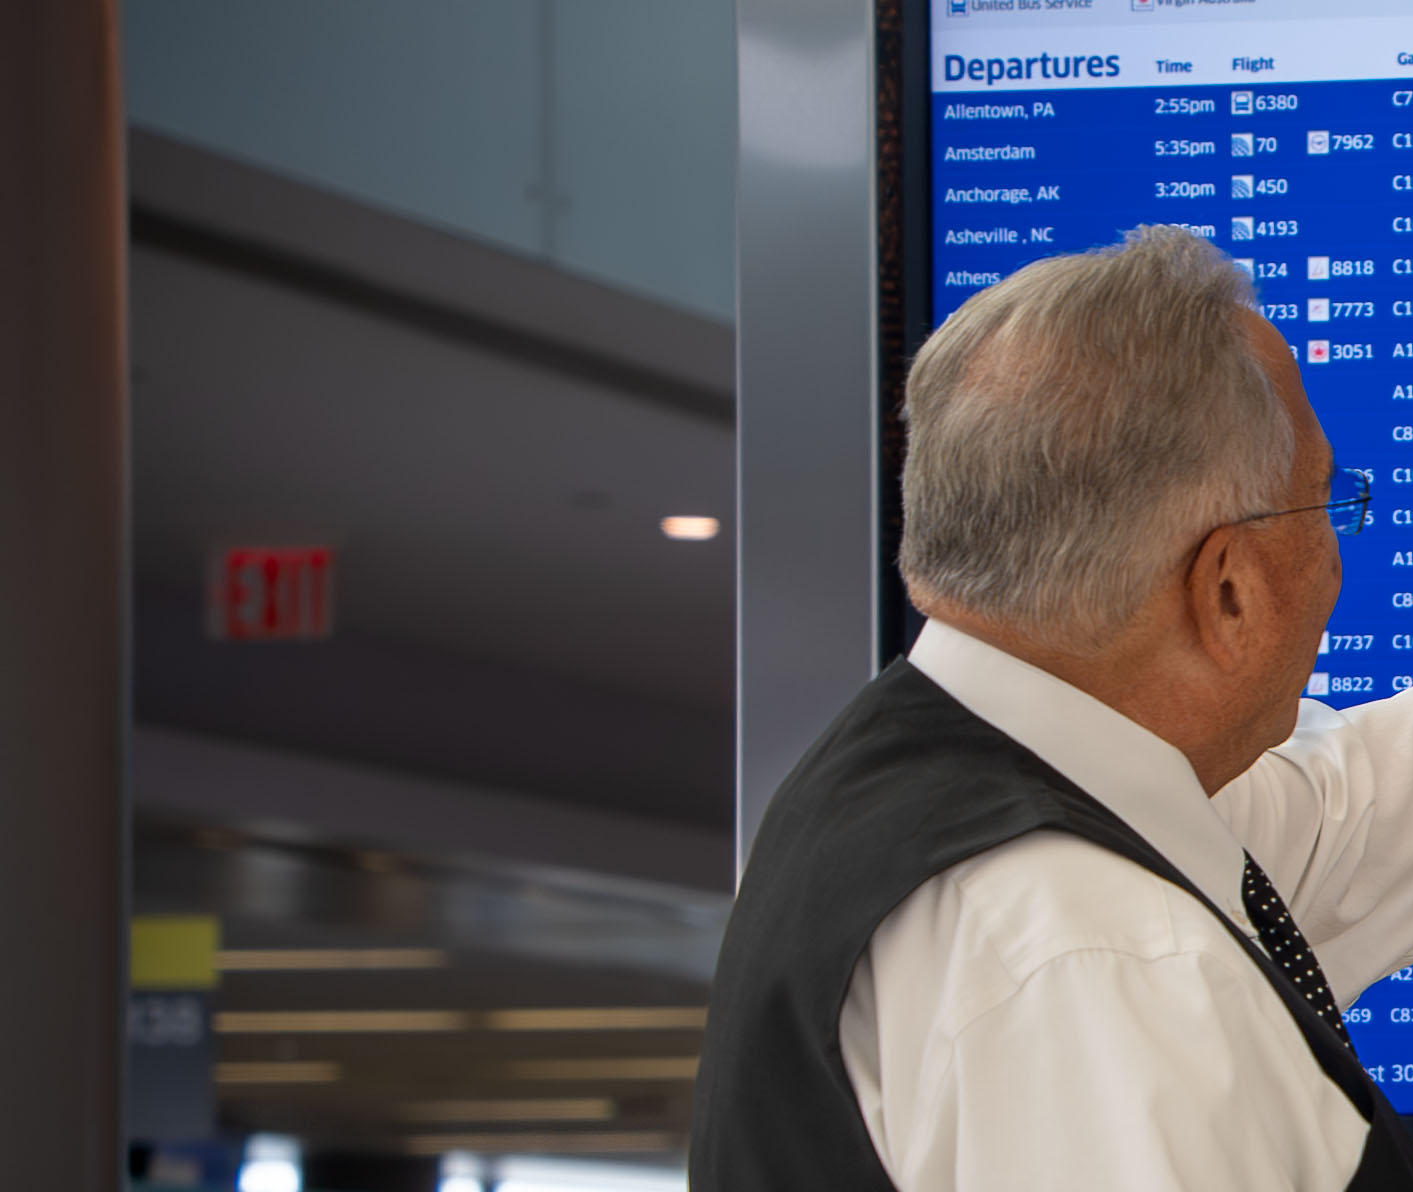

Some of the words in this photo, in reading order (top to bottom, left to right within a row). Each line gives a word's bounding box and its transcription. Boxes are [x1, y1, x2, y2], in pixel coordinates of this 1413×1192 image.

[944, 52, 1121, 85] Departures
[1156, 59, 1193, 74] Time
[1231, 56, 1275, 73] Flight
[944, 103, 1029, 120] Allentown,
[1033, 102, 1055, 117] PA
[1154, 98, 1216, 116] 2:55pm
[1256, 93, 1298, 111] 6380
[944, 144, 1036, 161] Amsterdam
[1154, 139, 1216, 158] 5:35pm
[1256, 136, 1278, 153] 70
[1331, 133, 1375, 151] 7962
[1255, 220, 1299, 237] 4193
[224, 548, 332, 639] EXIT
